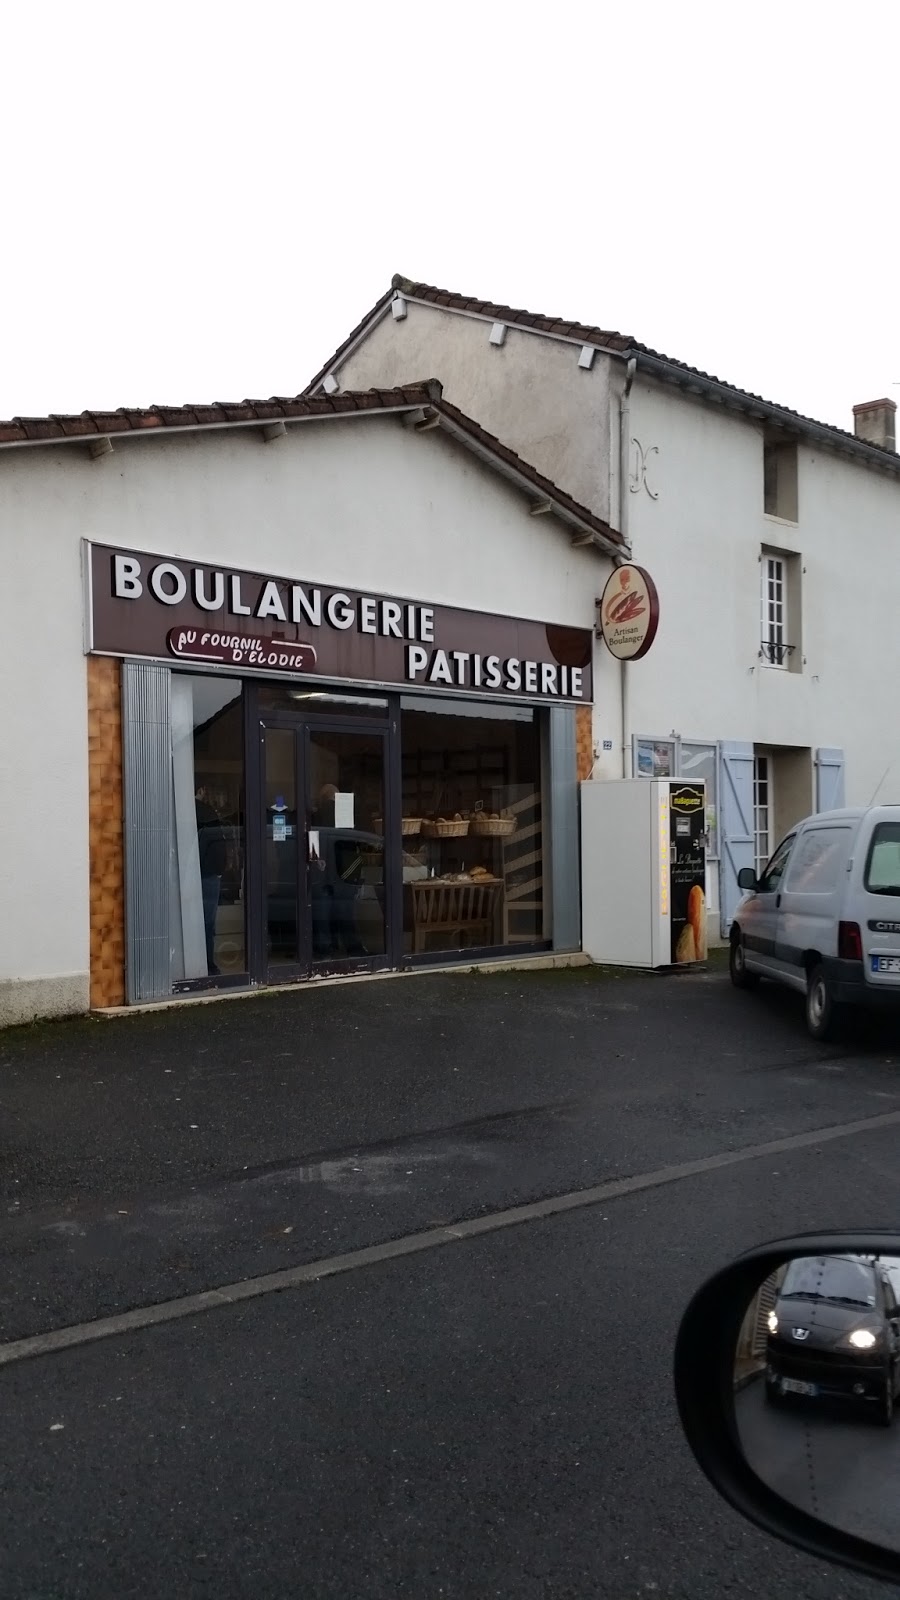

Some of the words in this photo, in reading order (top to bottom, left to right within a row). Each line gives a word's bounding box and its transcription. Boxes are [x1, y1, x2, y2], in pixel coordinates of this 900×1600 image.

[112, 554, 435, 643] BOULANGERIE
[614, 627, 639, 636] Artisan
[178, 630, 197, 650] AU
[200, 633, 263, 650] FOURNIL
[609, 635, 643, 645] Boulanger
[406, 645, 583, 697] PATISSERIE
[880, 958, 900, 970] EF-
